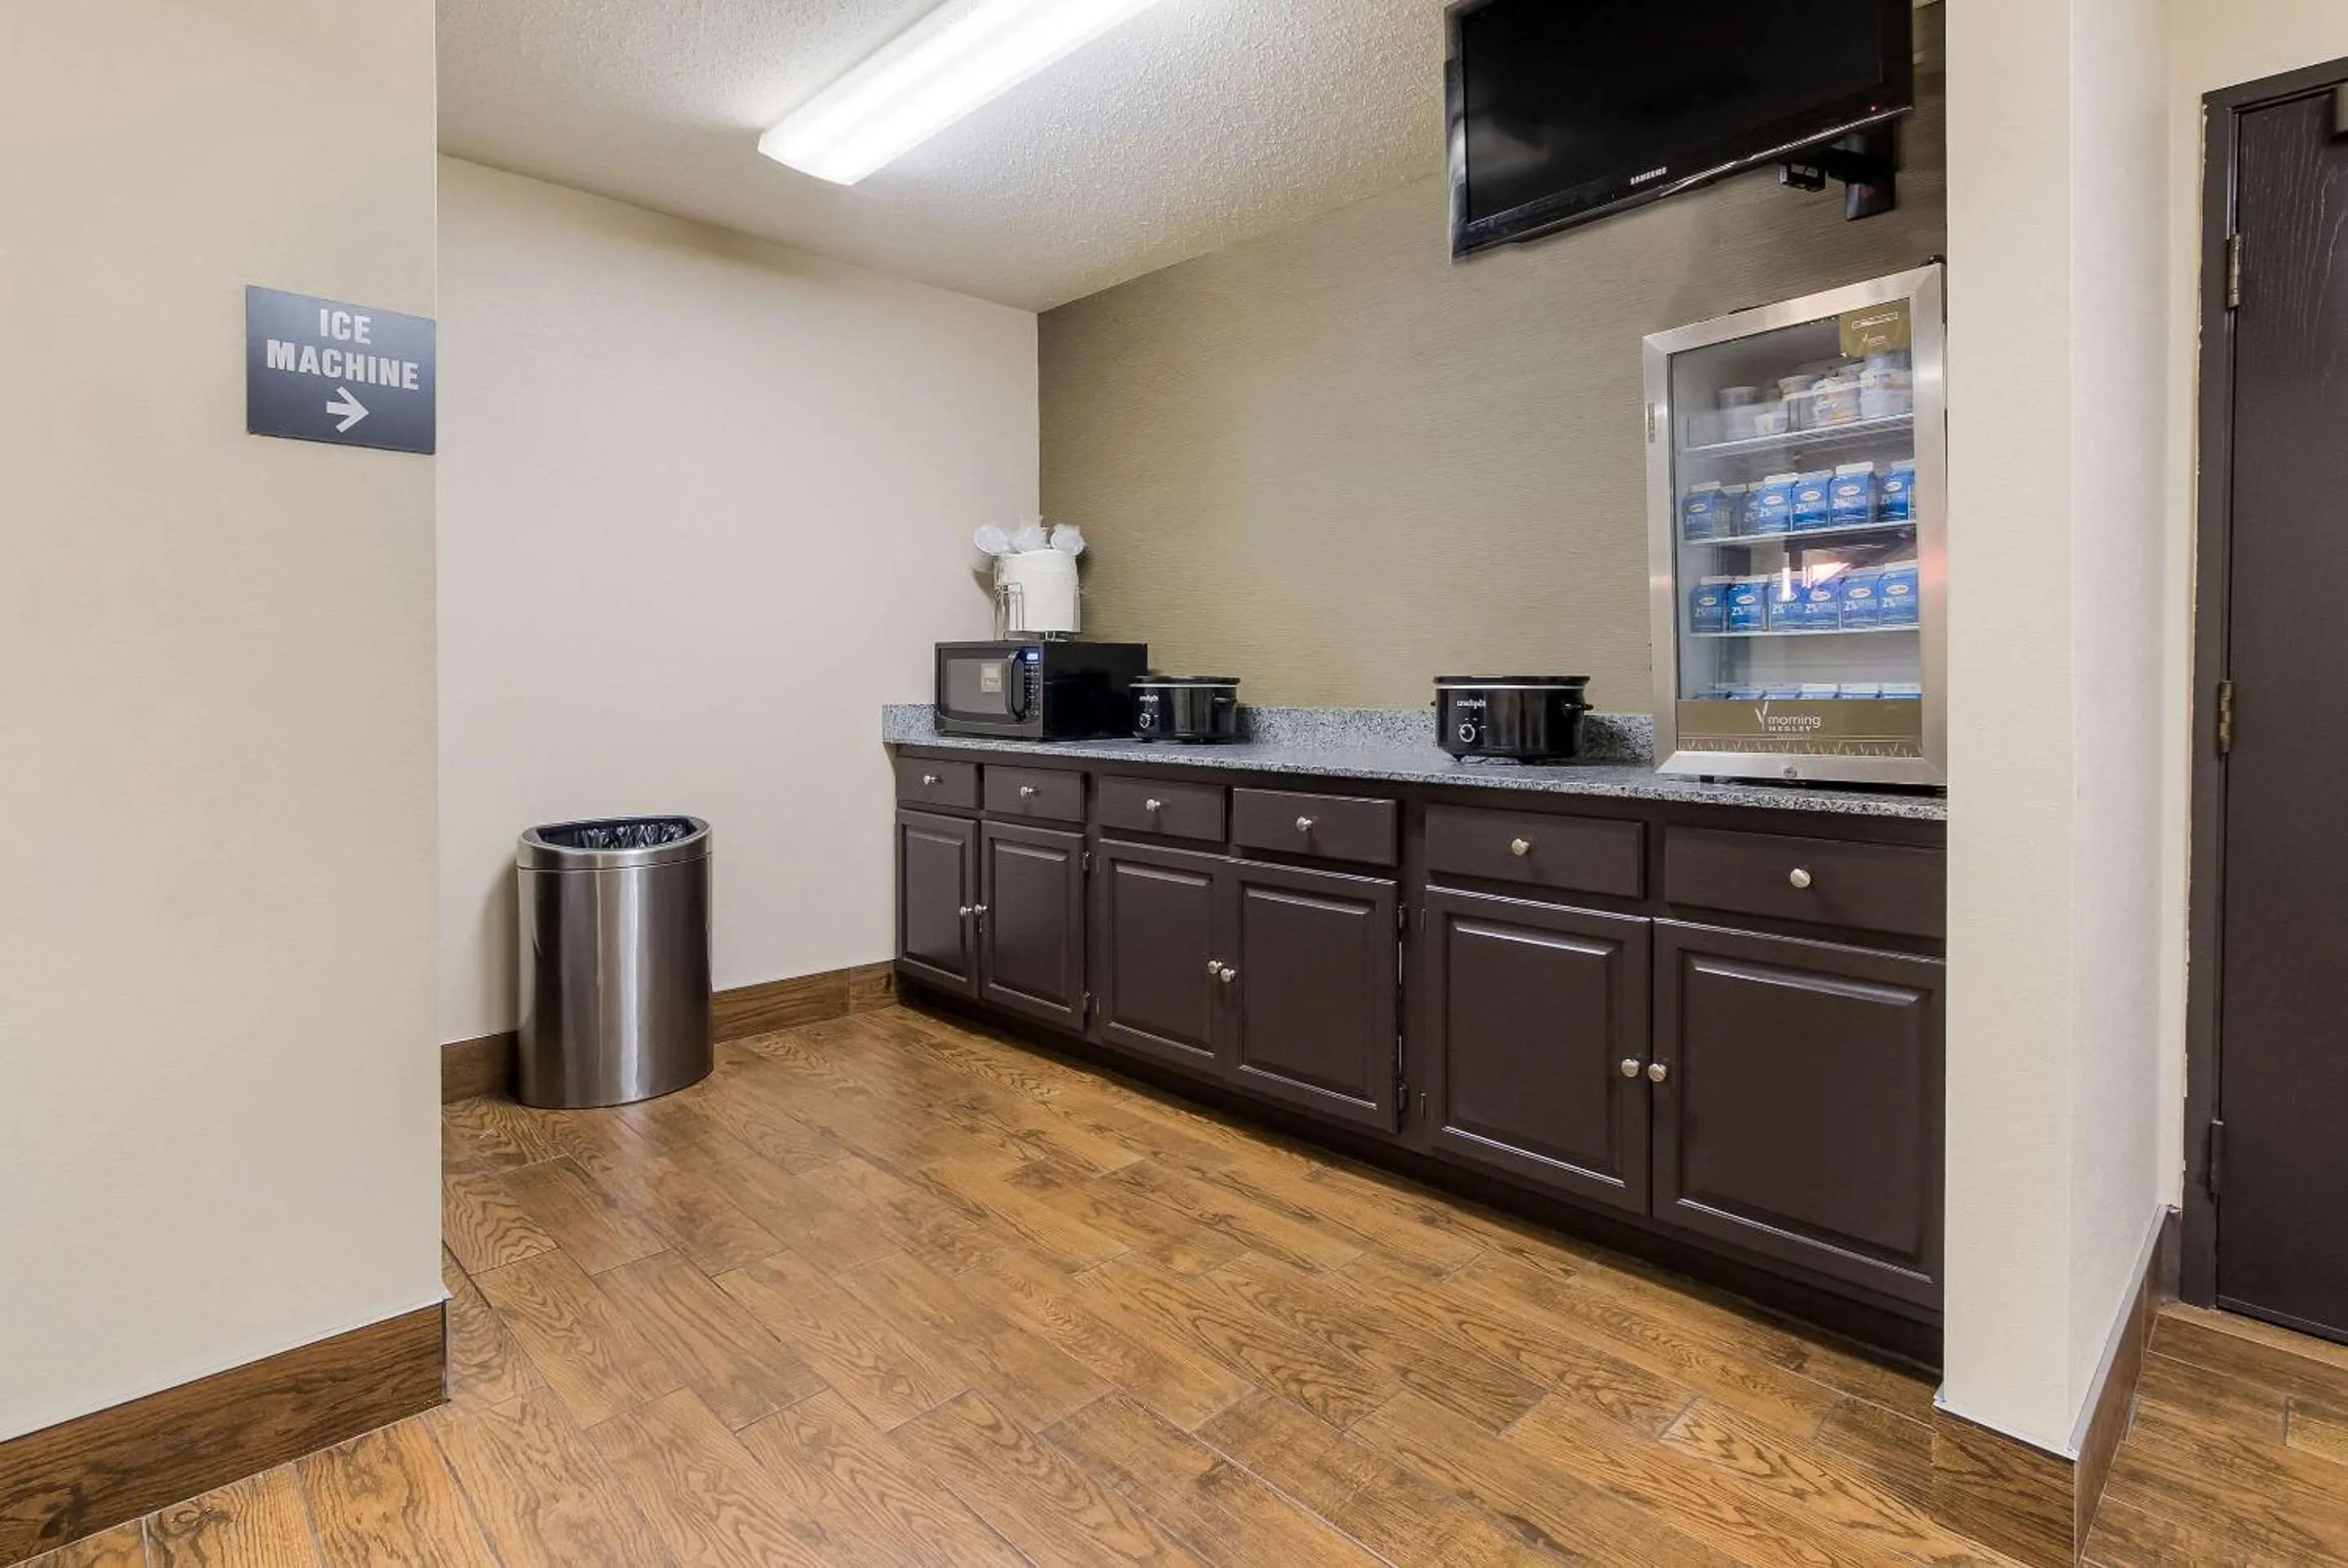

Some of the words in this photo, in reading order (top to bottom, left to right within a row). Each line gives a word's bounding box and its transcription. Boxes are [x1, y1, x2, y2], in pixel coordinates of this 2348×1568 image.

[1630, 166, 1667, 185] SAMSUNG
[319, 308, 372, 345] ICE
[266, 338, 420, 391] MACHINE
[1768, 713, 1821, 728] morning
